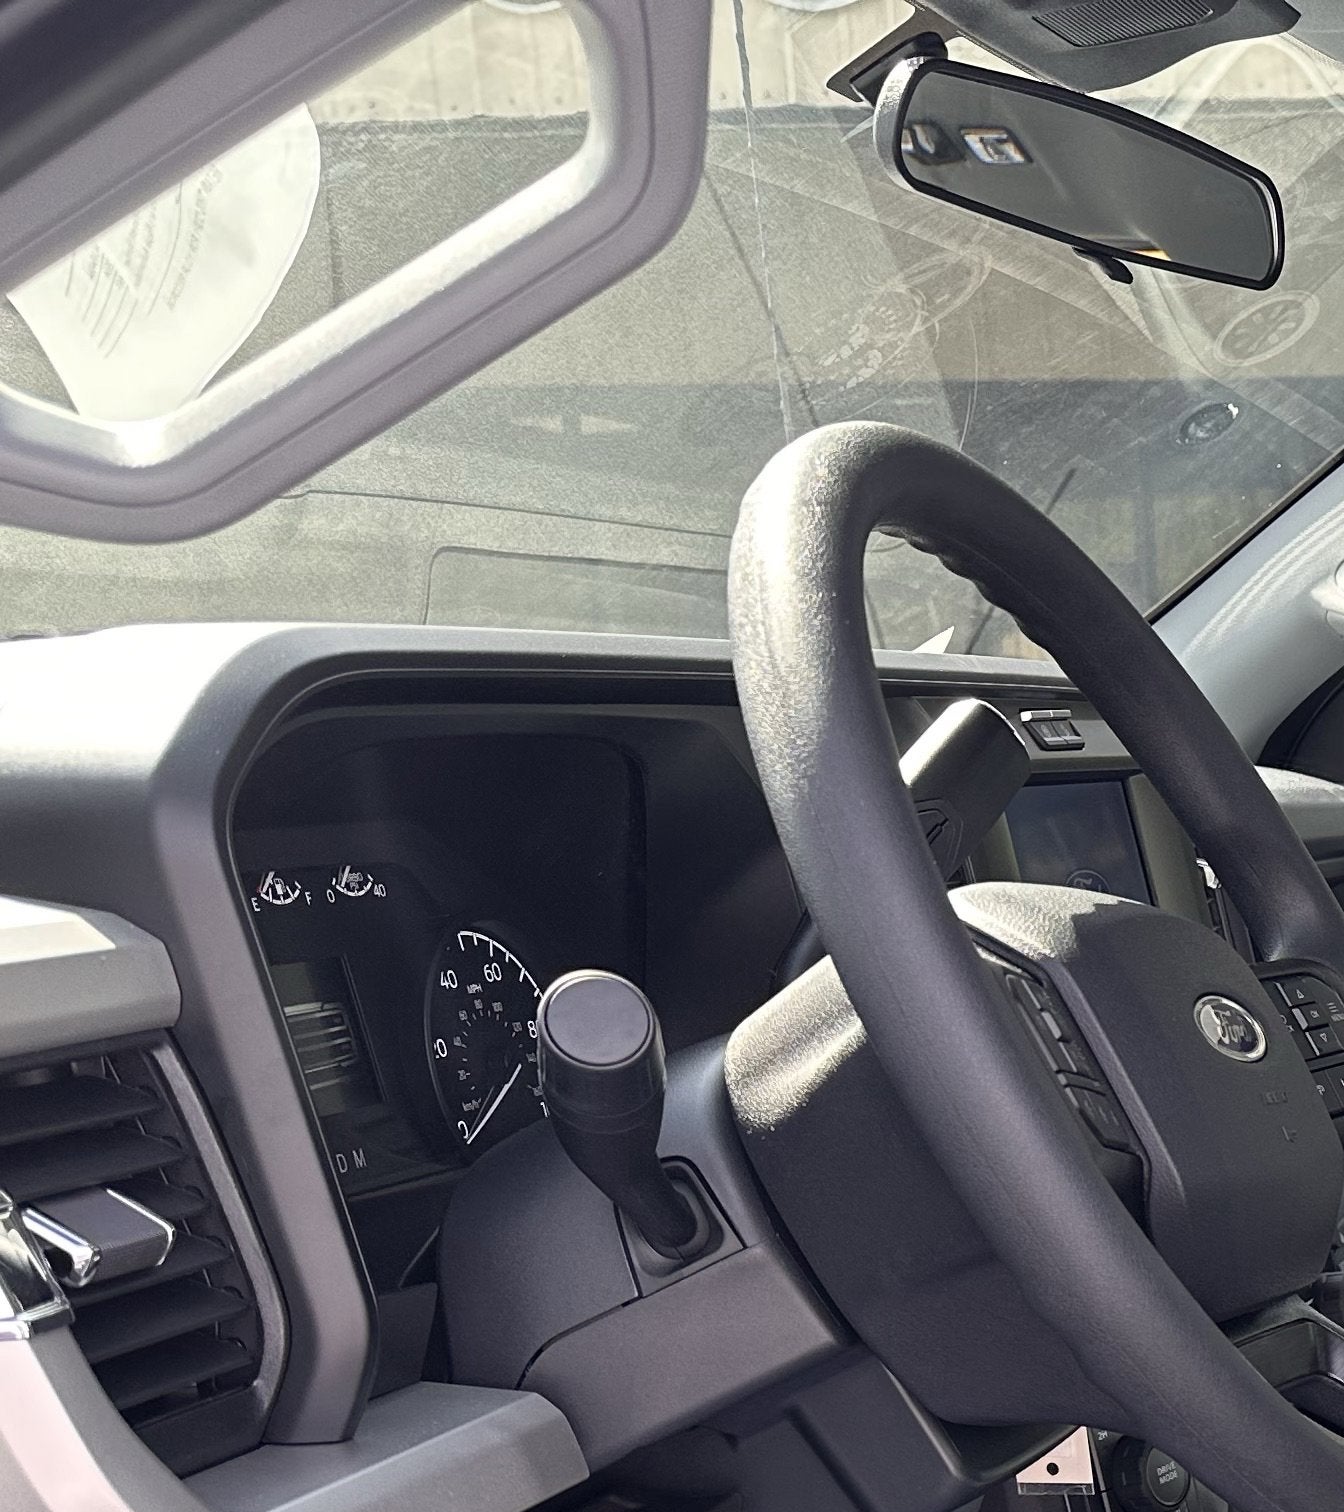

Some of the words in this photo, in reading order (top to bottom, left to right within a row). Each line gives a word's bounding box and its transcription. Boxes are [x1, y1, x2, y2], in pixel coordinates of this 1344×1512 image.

[373, 883, 386, 898] 40
[251, 897, 260, 912] E
[304, 891, 312, 906] F
[440, 969, 458, 990] 40
[484, 962, 502, 982] 60
[527, 1020, 538, 1039] 8
[434, 1038, 448, 1059] 0
[336, 1153, 348, 1174] D
[352, 1147, 367, 1169] M
[1156, 1460, 1177, 1476] DRIVE
[1159, 1470, 1179, 1485] MODE
